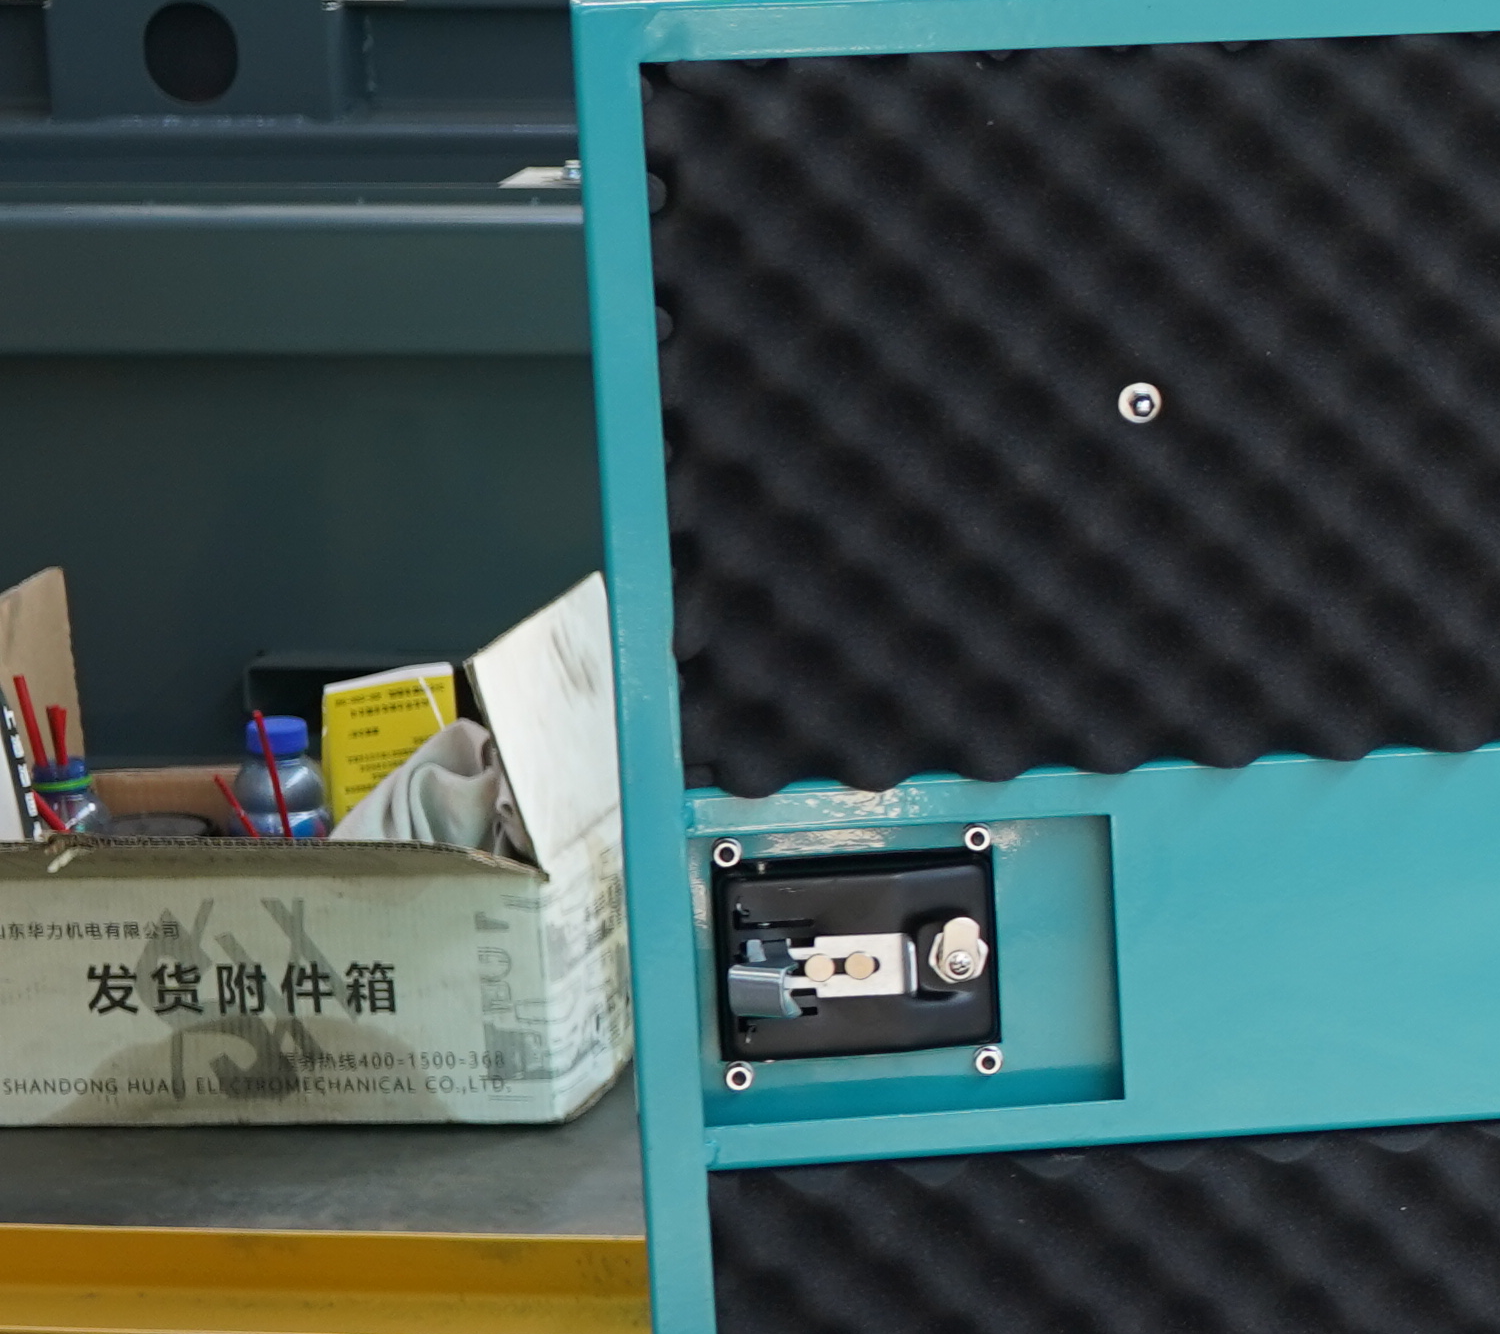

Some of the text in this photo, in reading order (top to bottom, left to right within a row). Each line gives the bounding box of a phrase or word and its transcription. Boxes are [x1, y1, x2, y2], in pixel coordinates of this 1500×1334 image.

[0, 920, 181, 941] 东华力机电有限公司
[86, 962, 397, 1015] 发货附件箱
[3, 1077, 118, 1096] SHANDONG
